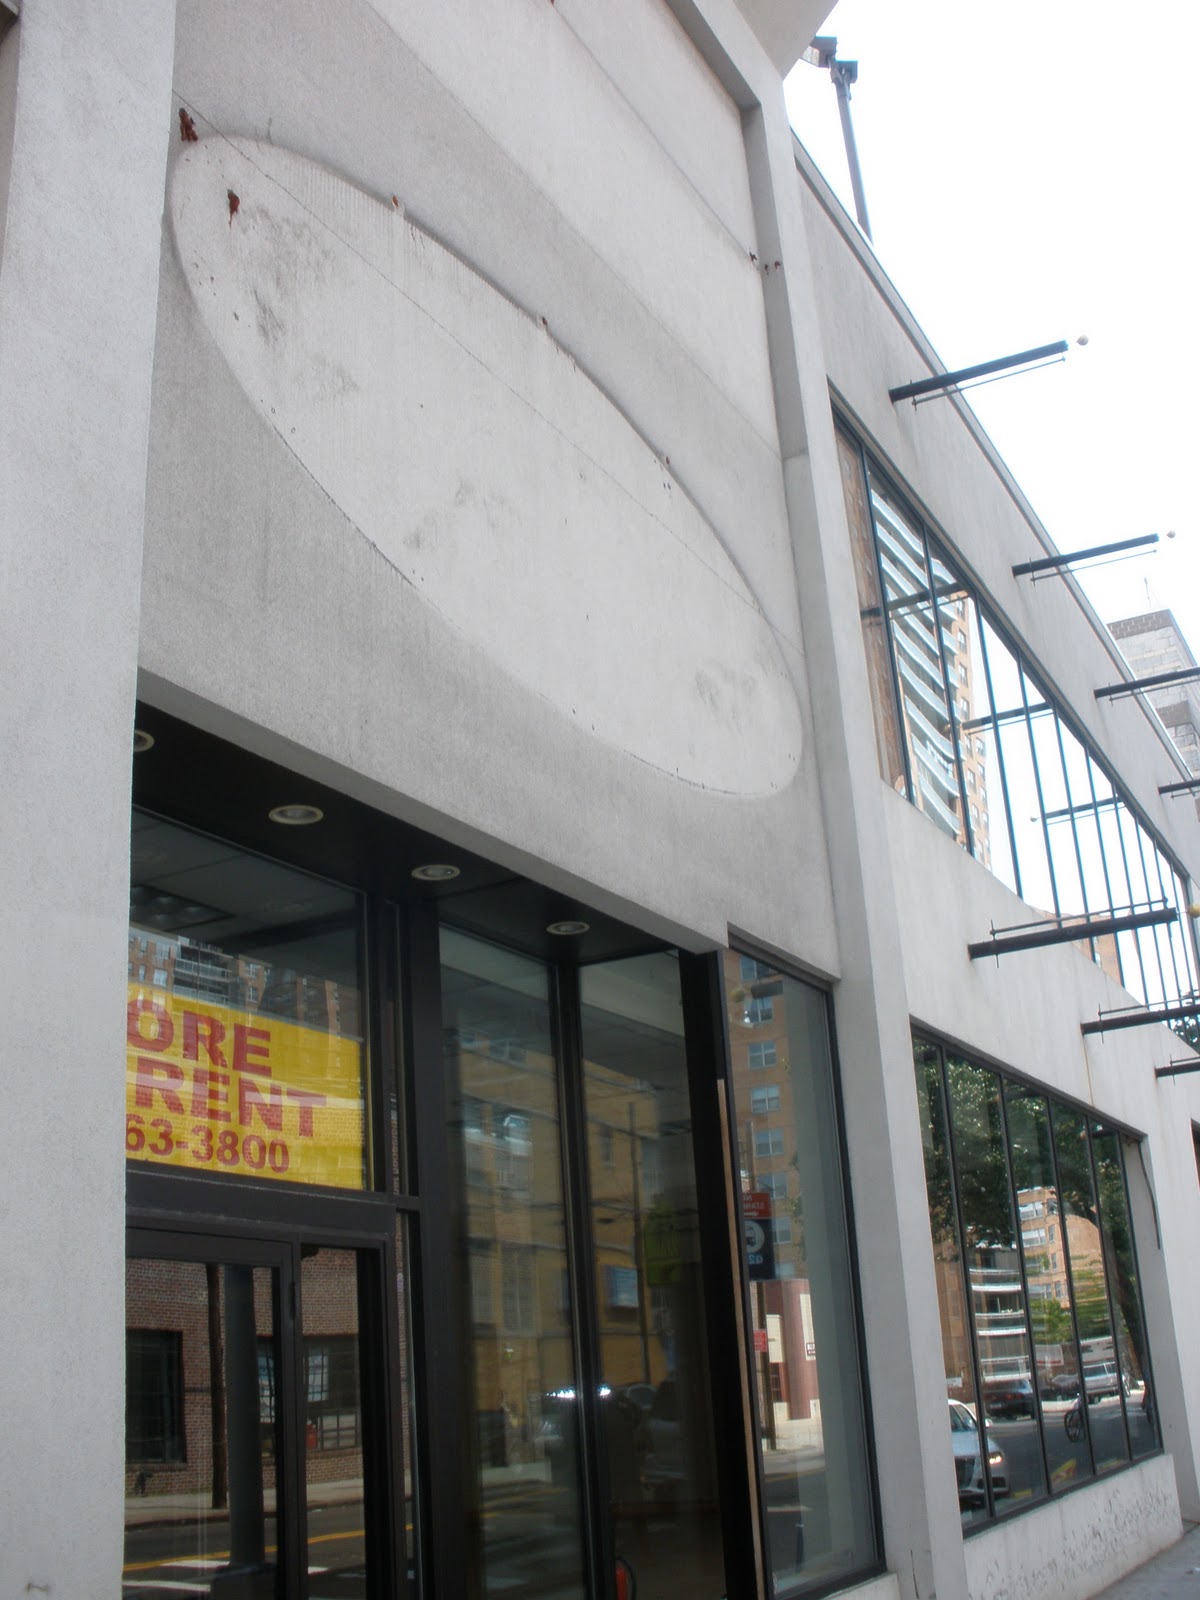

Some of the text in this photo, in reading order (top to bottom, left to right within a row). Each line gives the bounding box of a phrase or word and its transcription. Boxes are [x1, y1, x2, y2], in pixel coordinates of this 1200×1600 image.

[127, 998, 272, 1077] ORE
[135, 1056, 327, 1137] RENT
[126, 1113, 290, 1173] 63-3800
